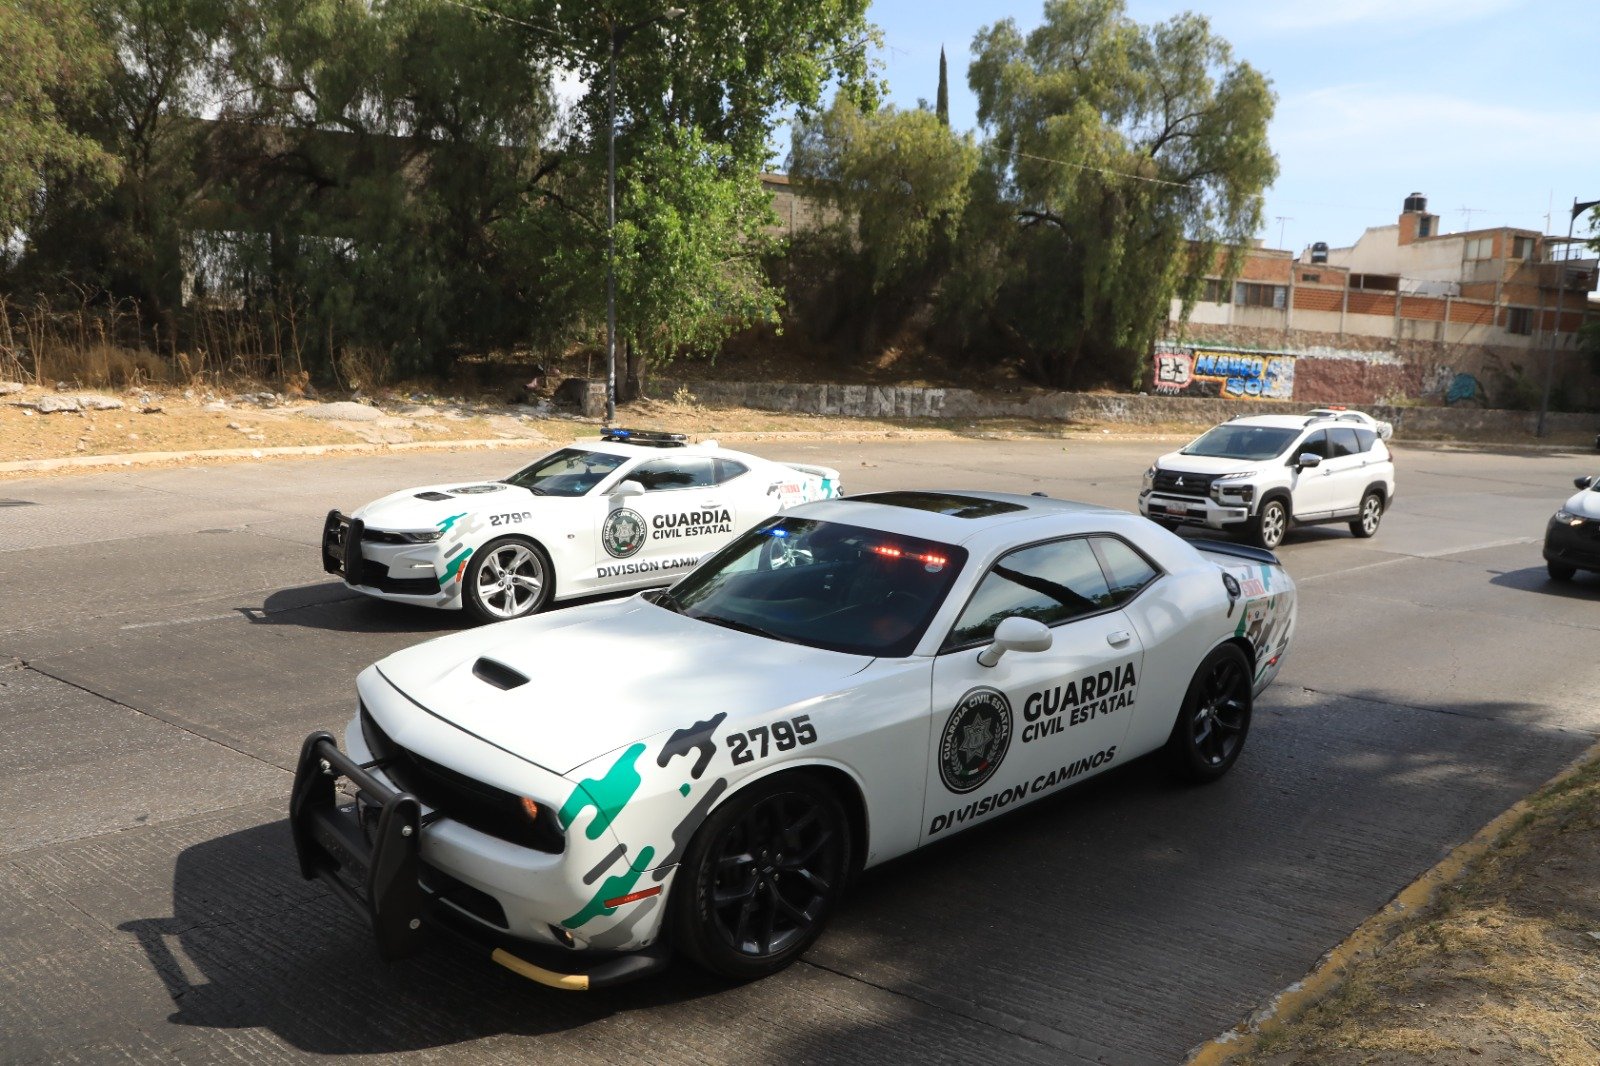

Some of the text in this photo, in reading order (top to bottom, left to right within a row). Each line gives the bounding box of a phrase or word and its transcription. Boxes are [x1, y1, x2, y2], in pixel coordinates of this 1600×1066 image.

[1160, 356, 1190, 384] 23
[652, 509, 732, 529] GUARDIA
[652, 524, 732, 540] CIVIL ESTATAL
[597, 559, 659, 579] DIVISIÓN
[1021, 690, 1135, 743] CIVIL ESTATAL
[1023, 662, 1136, 722] GUARDIA
[726, 714, 818, 766] 2795
[943, 694, 1009, 760] GUARDIA CIVIL ESTATAL
[928, 781, 1029, 835] DIVISION
[1030, 745, 1117, 794] CAMINOS
